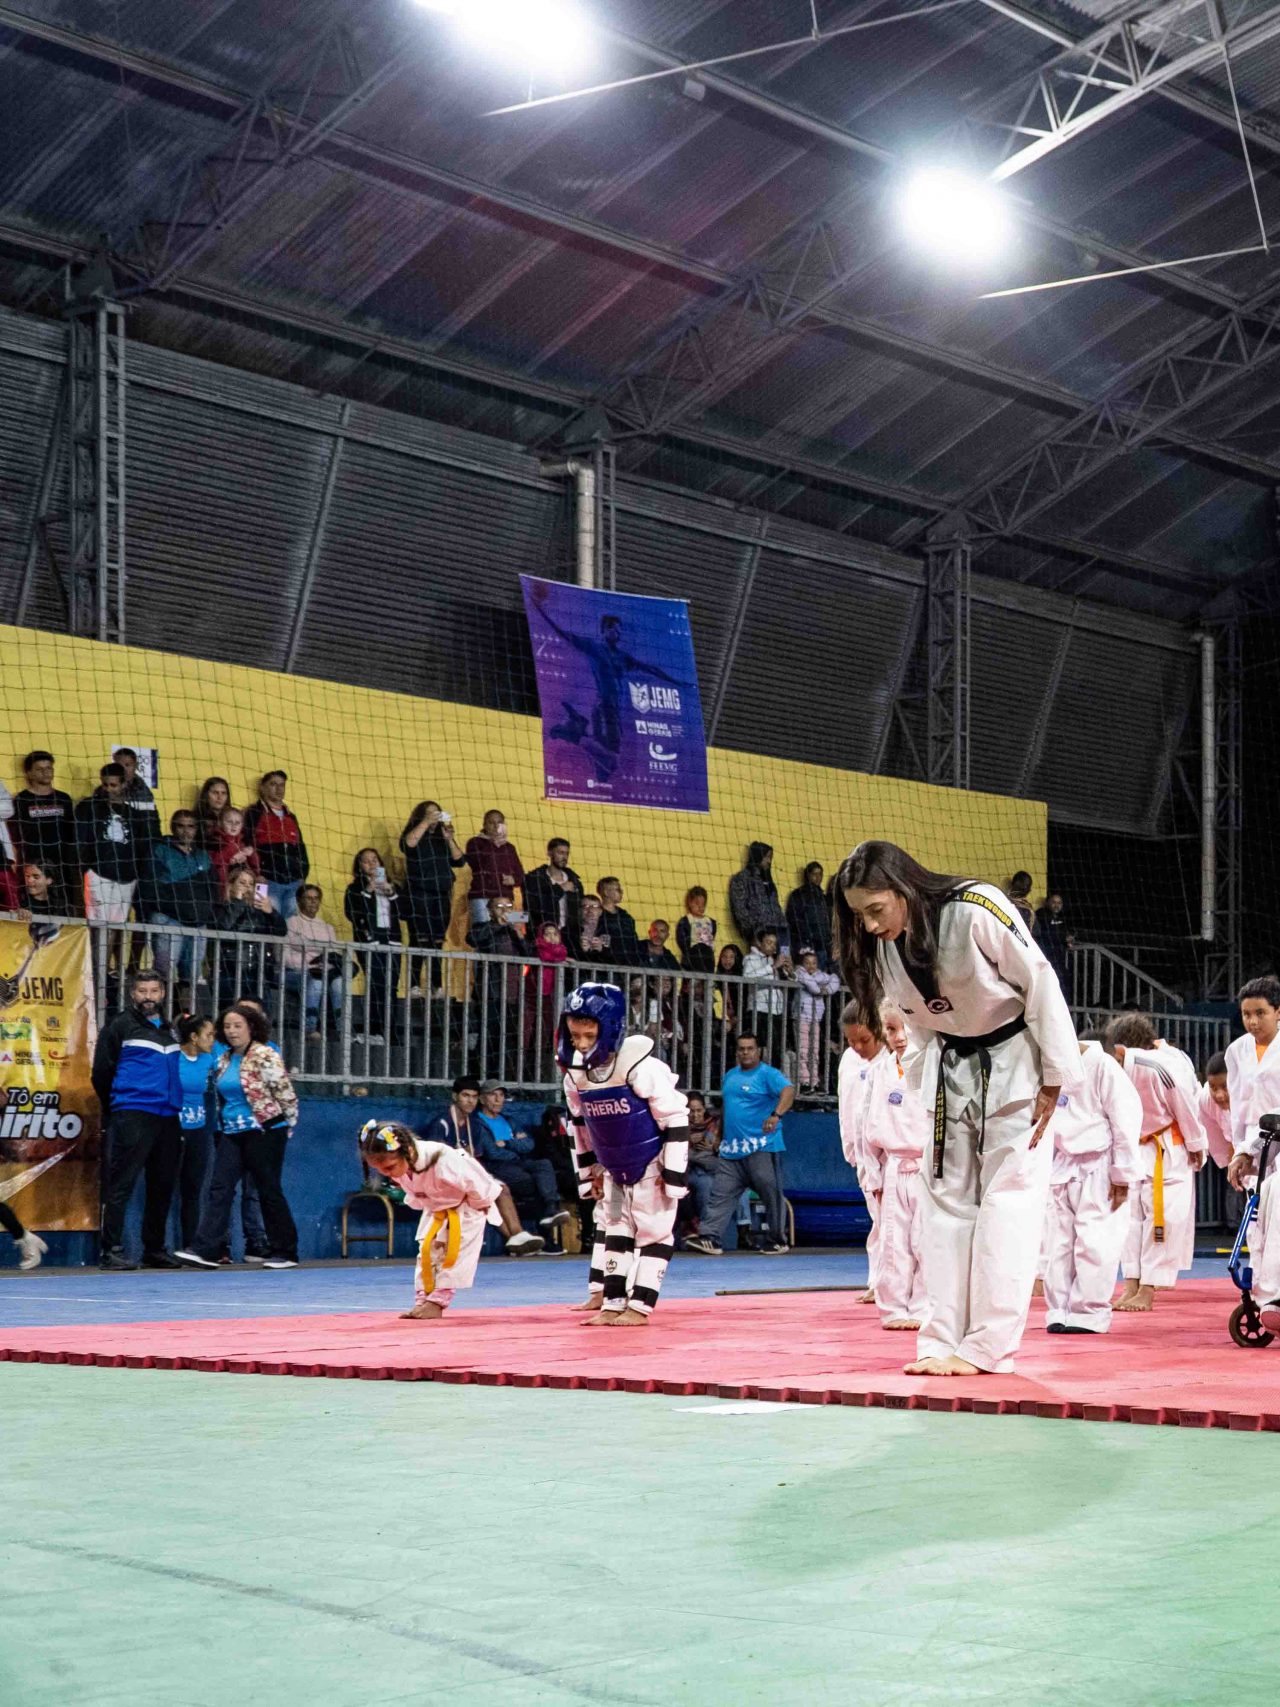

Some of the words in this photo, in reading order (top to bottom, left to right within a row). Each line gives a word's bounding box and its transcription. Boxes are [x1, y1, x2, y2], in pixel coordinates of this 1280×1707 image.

[650, 686, 681, 711] JEMG
[962, 891, 1012, 927] TAEKWONDO
[22, 976, 64, 1001] JEMG
[8, 1088, 29, 1104] Tô
[33, 1092, 59, 1105] em
[0, 1105, 82, 1139] irito
